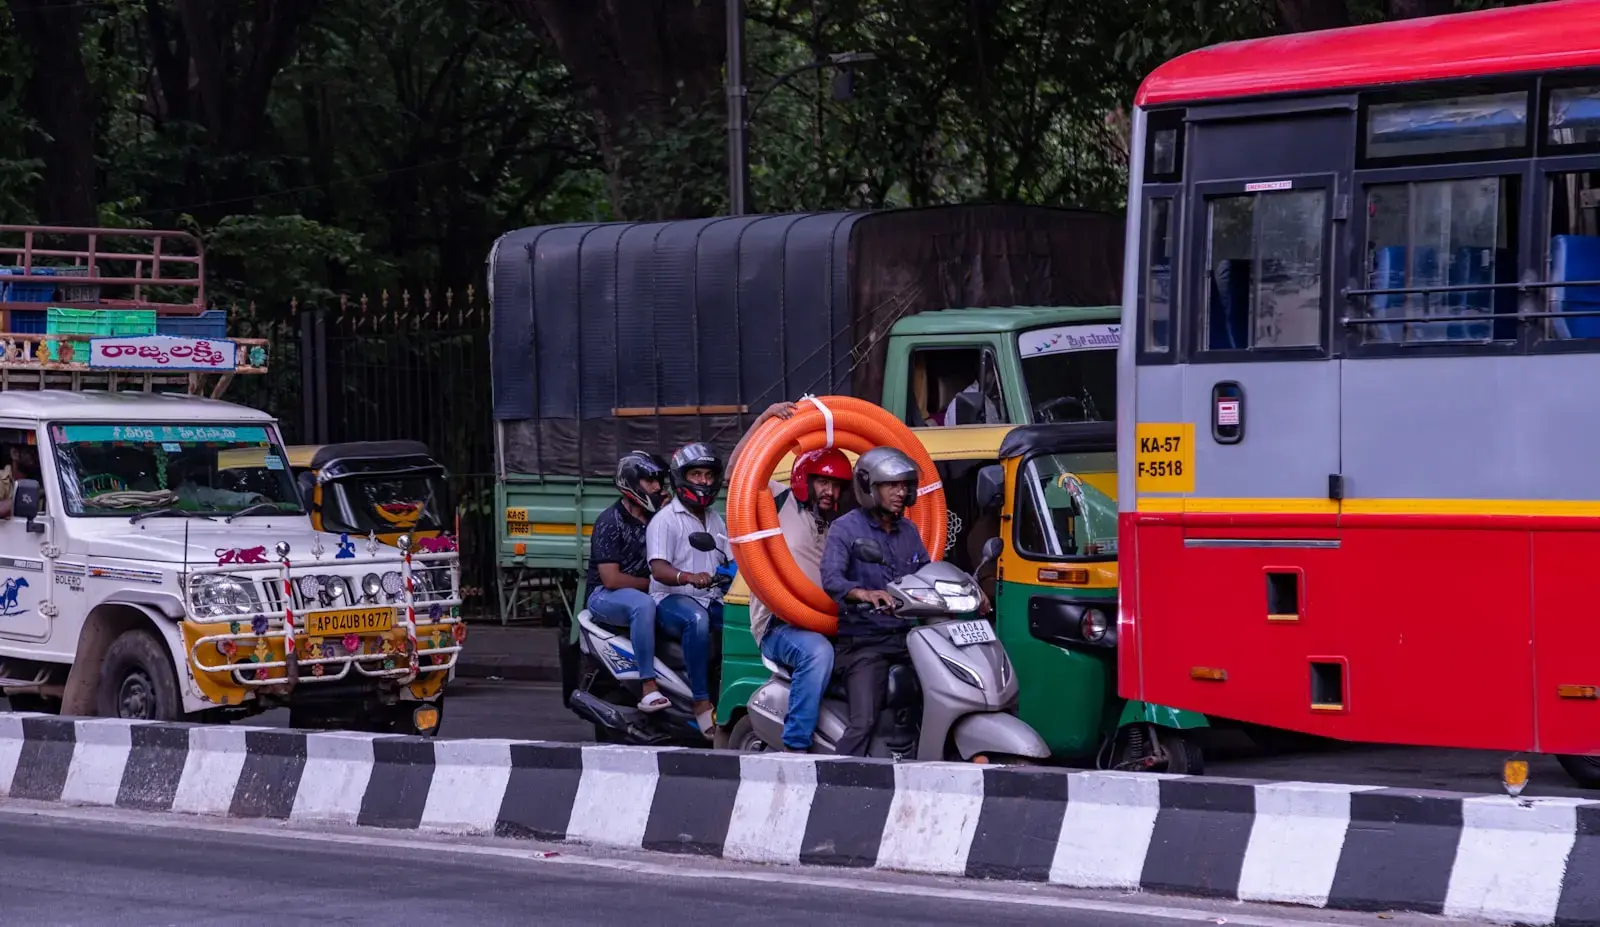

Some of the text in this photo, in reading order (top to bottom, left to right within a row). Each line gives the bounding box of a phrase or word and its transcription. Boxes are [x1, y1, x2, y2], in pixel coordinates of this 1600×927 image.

[101, 341, 225, 365] రాజ్యలక్ష్మి
[1141, 437, 1181, 453] KA-57
[1138, 460, 1182, 477] F-5518
[56, 575, 81, 586] BOLERO
[317, 612, 389, 631] AP04UB1877
[956, 622, 984, 633] KA04J
[961, 631, 989, 643] S3550
